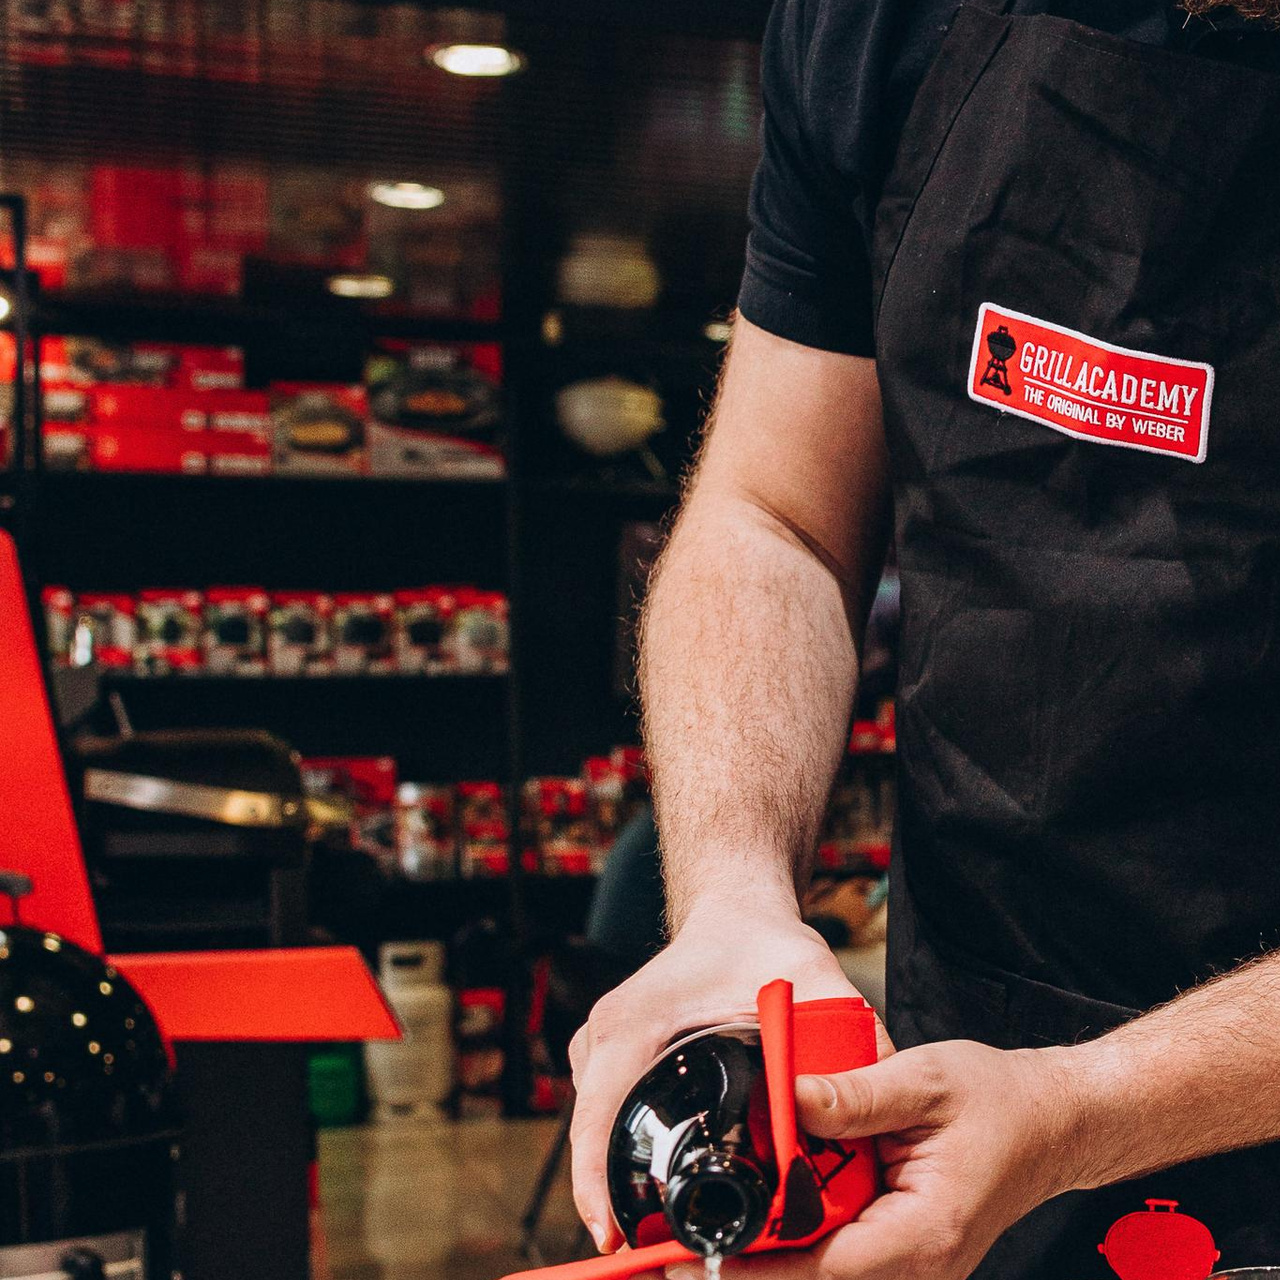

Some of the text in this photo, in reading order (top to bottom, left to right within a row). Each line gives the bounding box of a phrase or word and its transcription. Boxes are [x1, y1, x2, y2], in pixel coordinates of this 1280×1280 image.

[1020, 342, 1198, 416] GRILLACADEMY
[1023, 384, 1185, 442] THE ORIGINAL BY WEBER
